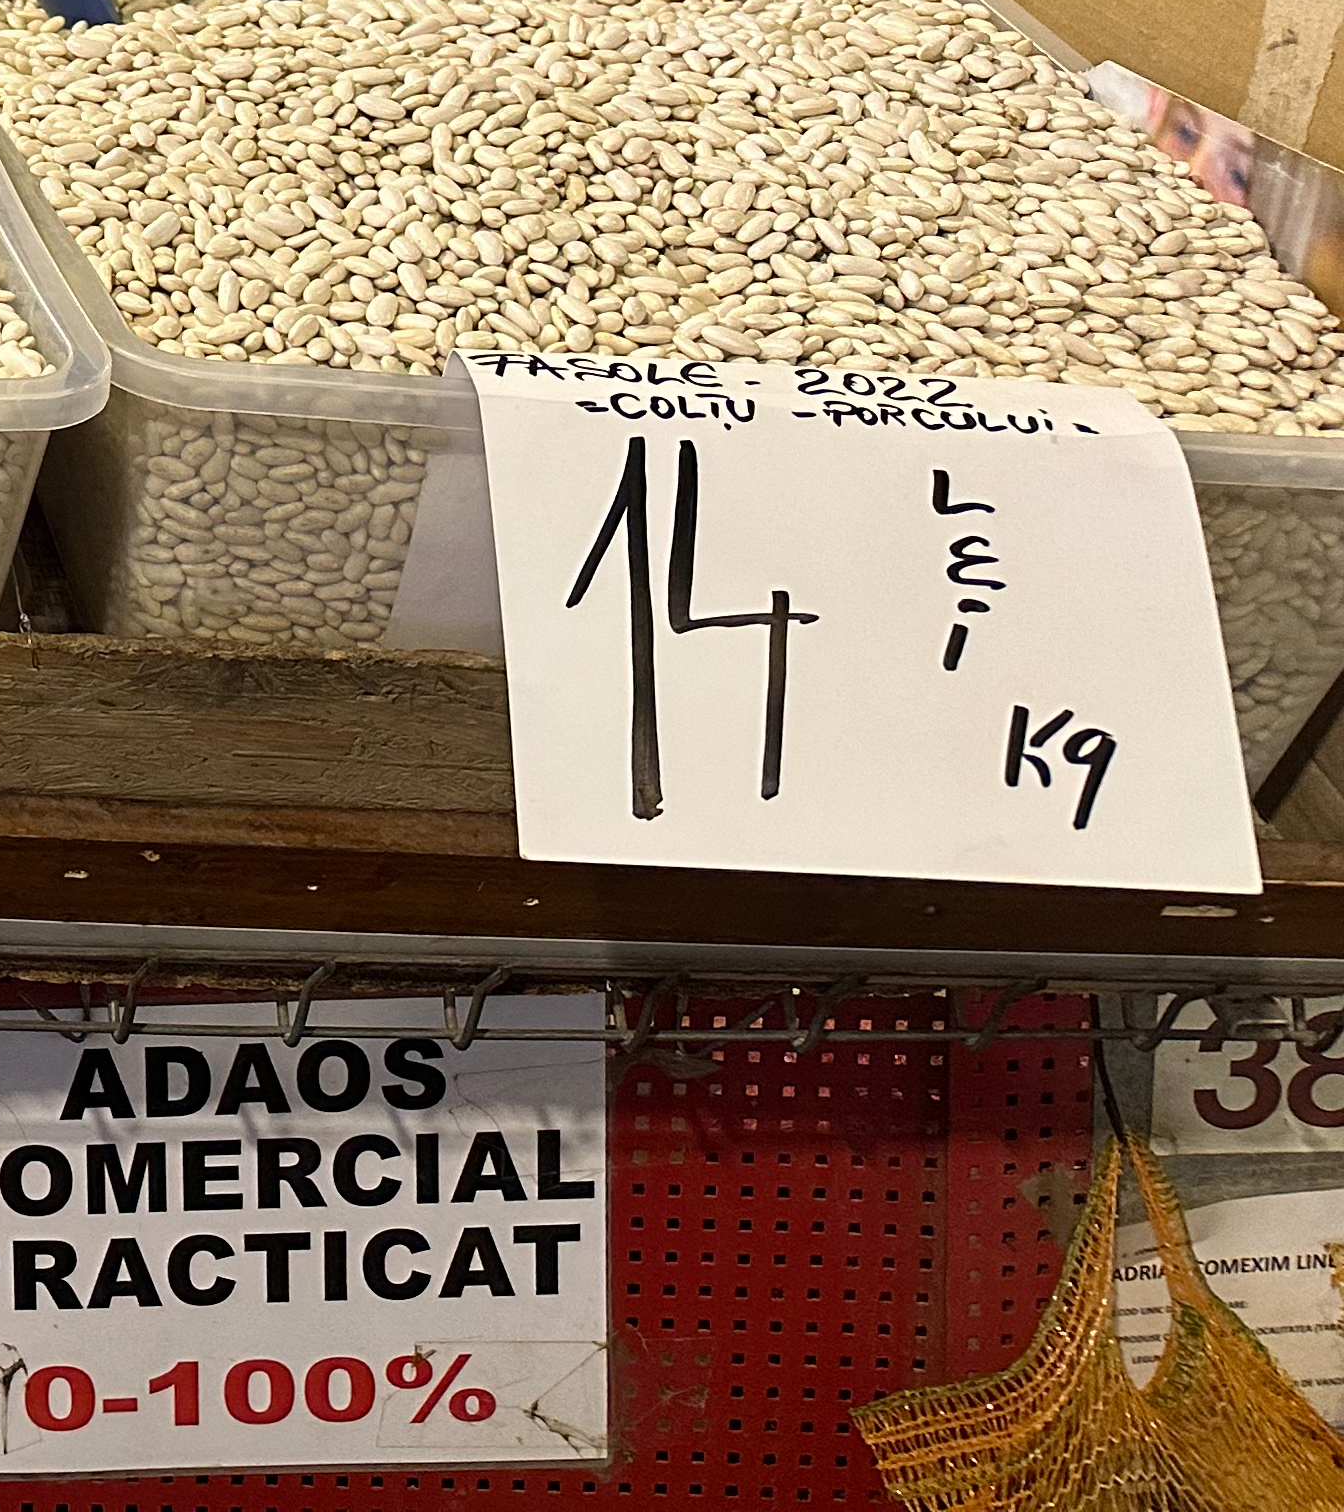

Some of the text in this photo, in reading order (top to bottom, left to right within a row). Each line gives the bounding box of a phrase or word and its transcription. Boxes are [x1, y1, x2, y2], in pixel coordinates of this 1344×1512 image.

[794, 368, 972, 408] 2022
[566, 436, 819, 821] 14
[1004, 704, 1118, 831] Kg
[60, 1038, 447, 1122] ADAOS
[1112, 1264, 1166, 1282] ADRIA
[1198, 1256, 1290, 1276] OMEXIM
[24, 1353, 497, 1433] 0-100%
